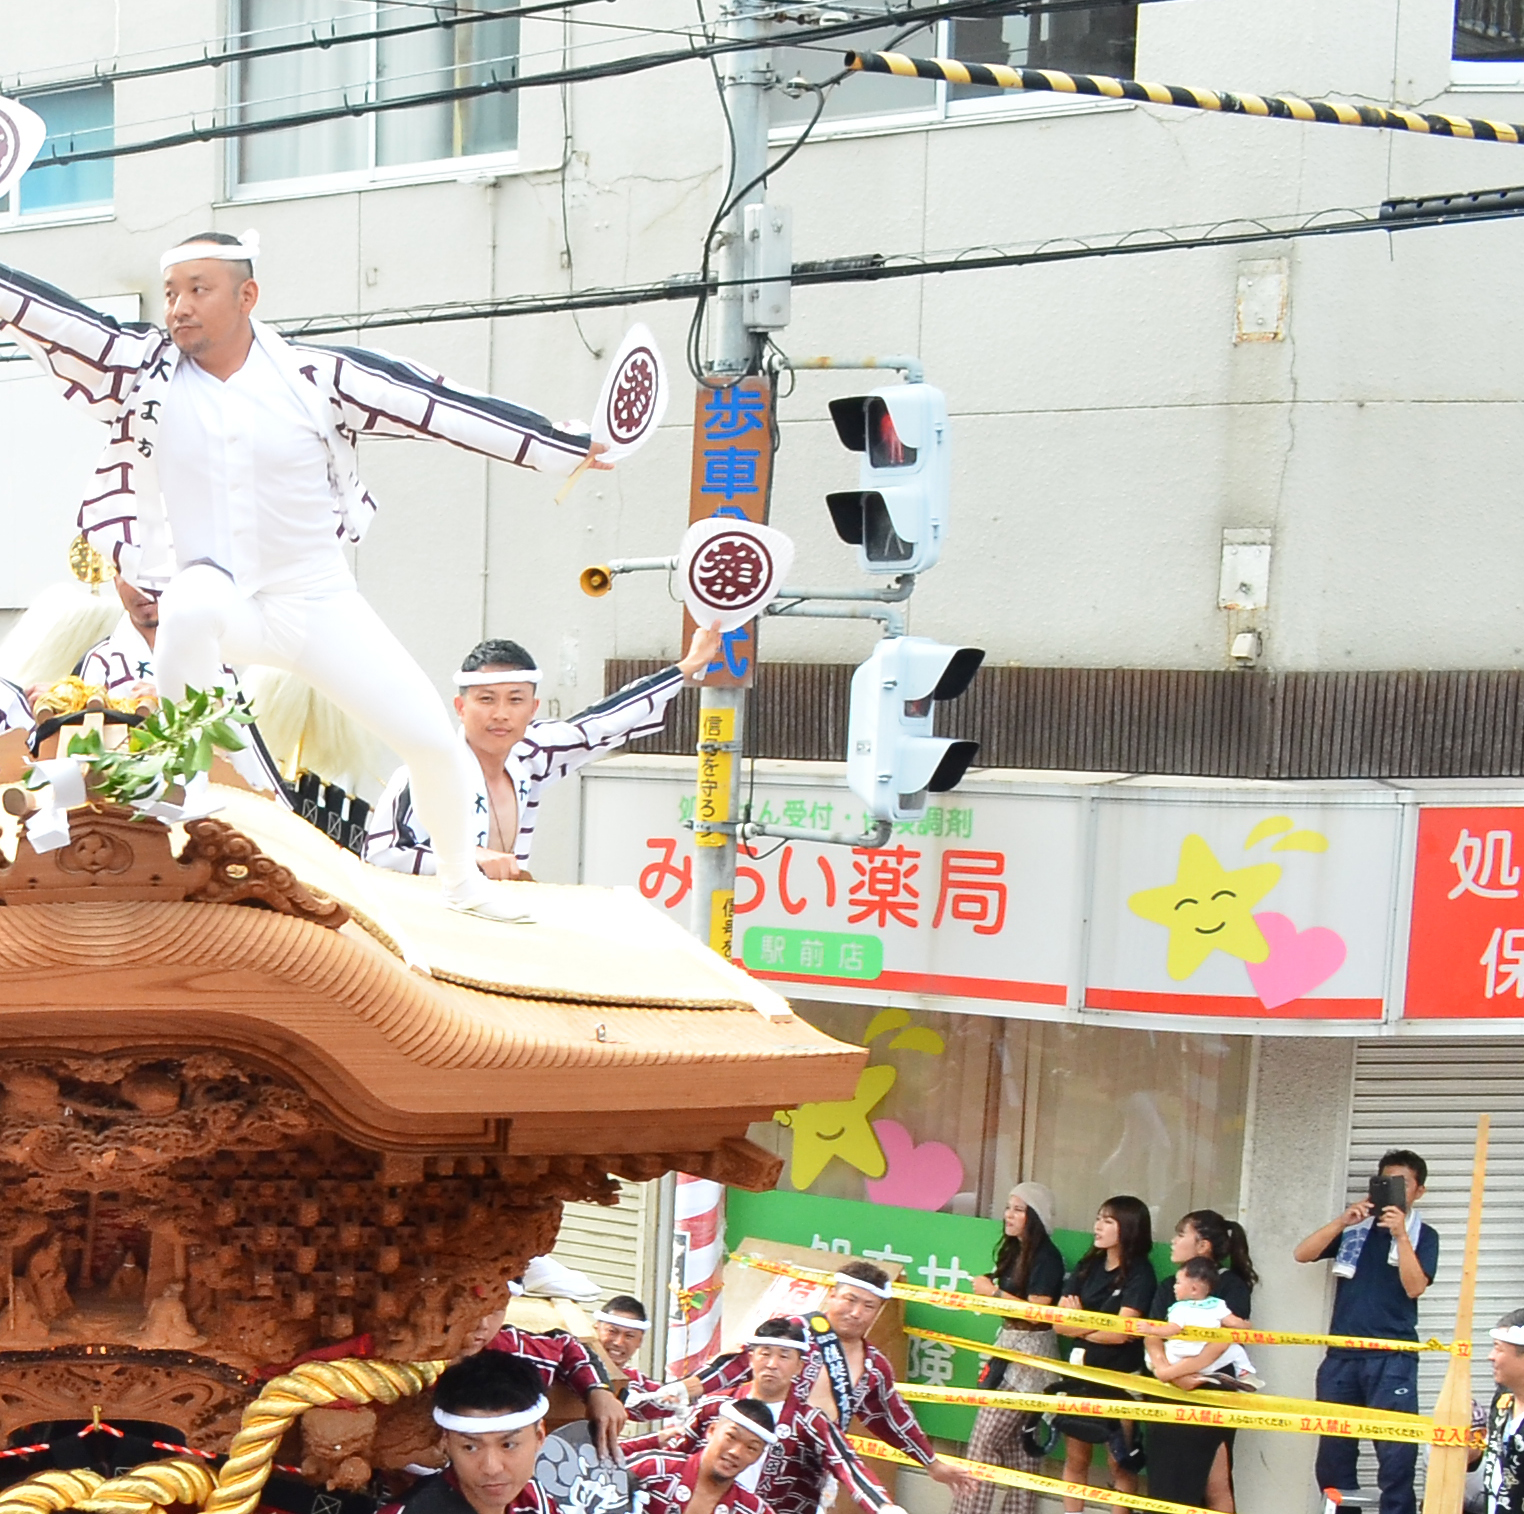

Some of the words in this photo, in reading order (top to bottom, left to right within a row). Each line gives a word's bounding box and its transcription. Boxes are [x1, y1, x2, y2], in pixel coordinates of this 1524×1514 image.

[474, 792, 488, 849] 大工
[761, 937, 865, 972] 駅前店
[1024, 1305, 1065, 1324] 立入禁止
[1056, 1399, 1104, 1415] 立入禁止
[1107, 1404, 1168, 1418] 入らないでください
[1174, 1407, 1225, 1425] 立入禁止
[1228, 1413, 1293, 1428] 入らないでください
[1300, 1416, 1352, 1435] 立入禁止
[1357, 1422, 1425, 1439] 入らないでください
